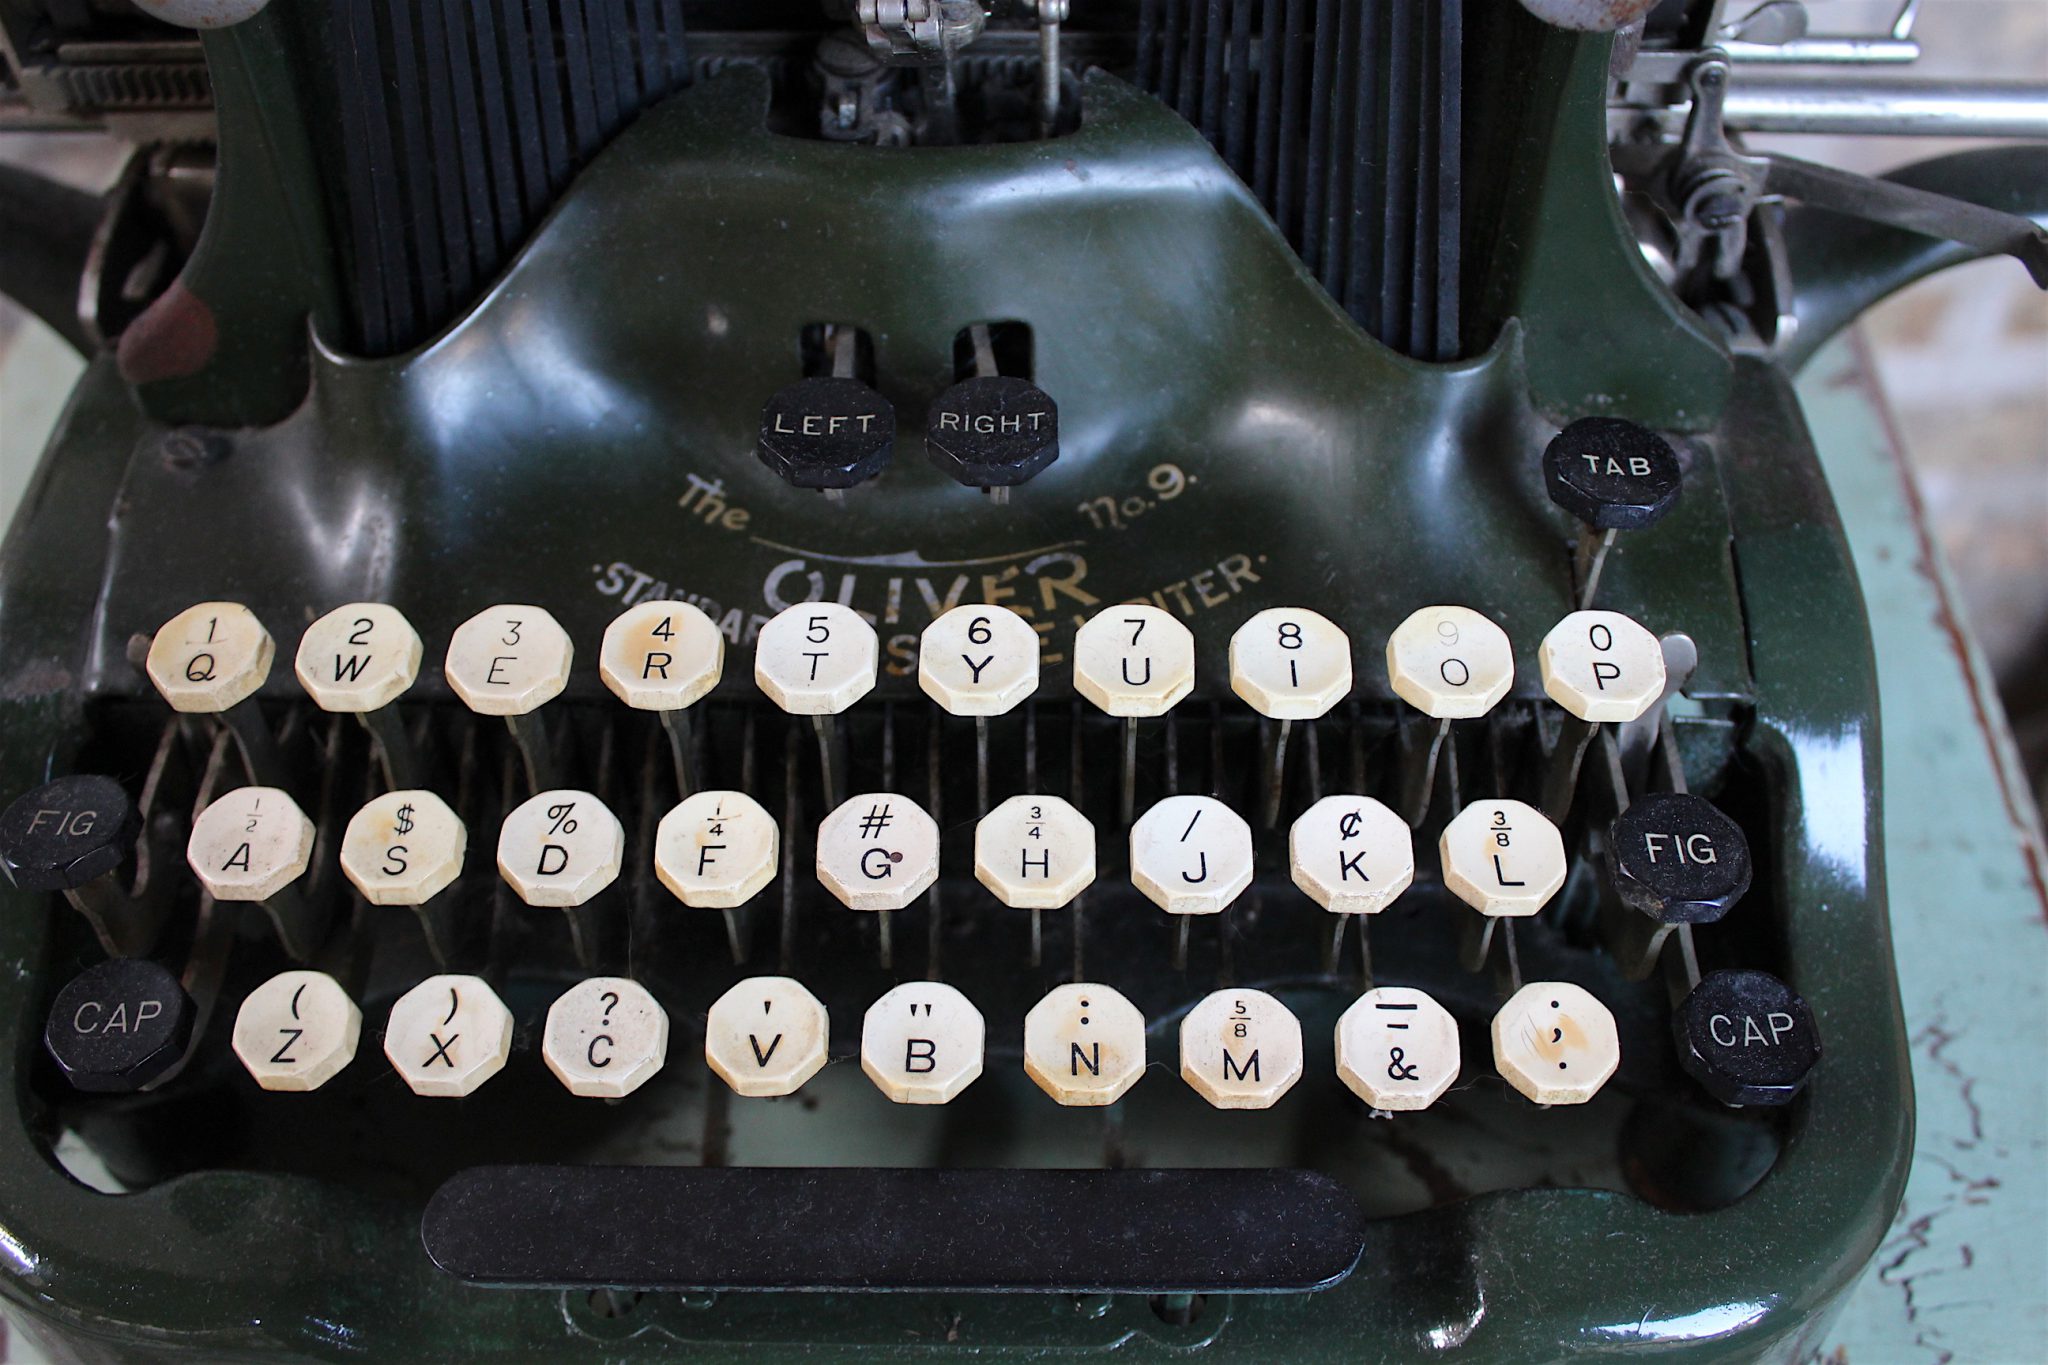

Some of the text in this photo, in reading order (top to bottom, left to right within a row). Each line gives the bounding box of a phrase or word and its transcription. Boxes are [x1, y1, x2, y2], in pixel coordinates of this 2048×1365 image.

[774, 411, 877, 436] LEFT
[938, 410, 1046, 434] RIGHT
[1580, 453, 1653, 478] TAB
[678, 473, 751, 530] The
[763, 551, 1101, 626] OLIVER
[347, 617, 375, 646] 2
[501, 620, 523, 647] 3
[651, 616, 676, 643] 4
[805, 615, 830, 644] 5
[967, 616, 993, 645] 6
[1123, 618, 1146, 647] 7
[1277, 621, 1303, 650] 8
[1436, 620, 1460, 647] 9
[185, 652, 217, 683] Q
[334, 653, 373, 683] W
[486, 656, 518, 685] E
[642, 652, 673, 680] R
[801, 652, 830, 681] T
[960, 653, 995, 685] Y
[1121, 656, 1151, 687] U
[1440, 657, 1470, 687] O
[1591, 661, 1621, 691] P
[26, 809, 97, 837] FIG
[220, 842, 251, 873] A
[381, 845, 409, 877] S
[536, 843, 569, 876] D
[697, 844, 727, 877] F
[860, 847, 892, 880] G
[1021, 847, 1049, 879] H
[1644, 832, 1718, 865] FIG
[1181, 851, 1208, 884] J
[1339, 850, 1371, 883] K
[1492, 854, 1526, 887] L
[73, 1000, 163, 1034] CAP
[1709, 1011, 1794, 1048] CAP
[269, 1028, 304, 1064] Z
[421, 1033, 460, 1069] X
[587, 1034, 615, 1069] C
[748, 1033, 783, 1068] V
[904, 1038, 937, 1073] B
[1070, 1041, 1100, 1076] N
[1222, 1047, 1260, 1076] M
[1387, 1046, 1420, 1081] &
